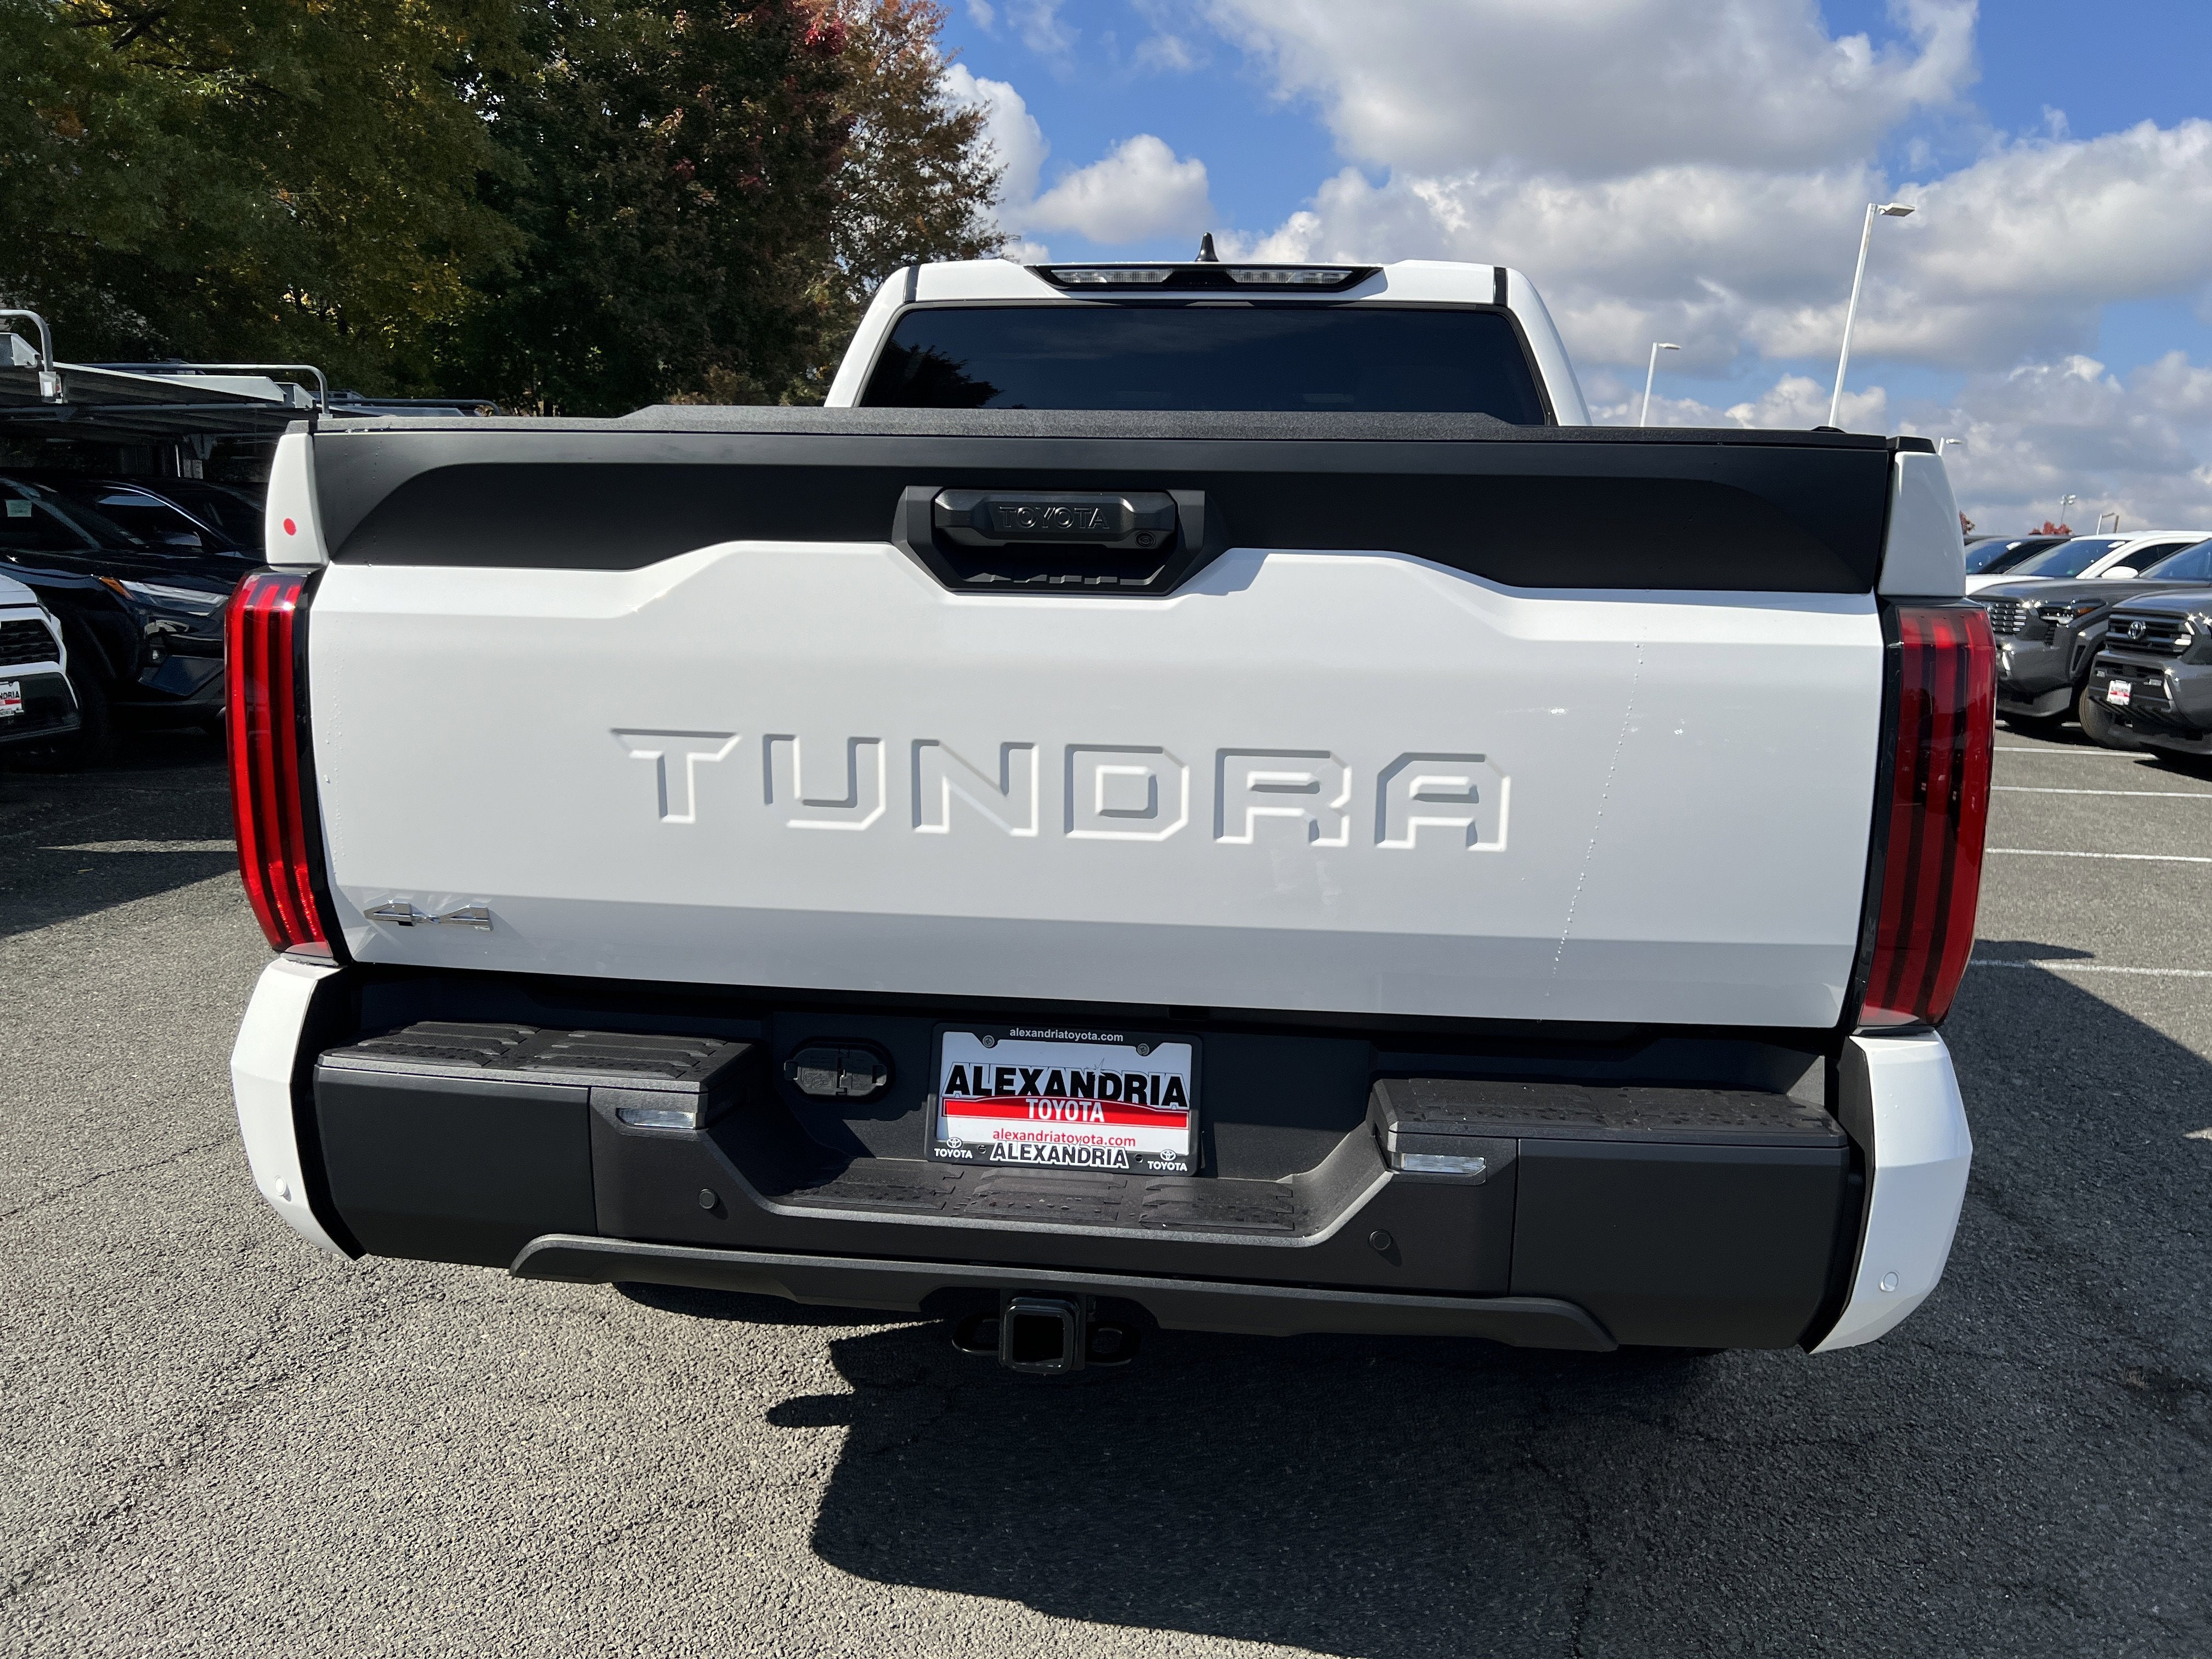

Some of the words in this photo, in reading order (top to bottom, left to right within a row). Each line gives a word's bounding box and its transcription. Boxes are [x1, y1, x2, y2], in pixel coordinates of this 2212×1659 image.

[999, 506, 1109, 530] TOYOTA
[609, 727, 1511, 852] TUNDRA
[1009, 1028, 1124, 1042] alexandriatoyota.com
[943, 1064, 1189, 1109] ALEXANDRIA
[1025, 1098, 1105, 1123] TOYOTA
[992, 1128, 1136, 1147] alexandriatoyota.com
[934, 1148, 973, 1159] TOYOTA
[990, 1142, 1129, 1169] ALEXANDRIA
[1147, 1160, 1188, 1171] TOYOTA
